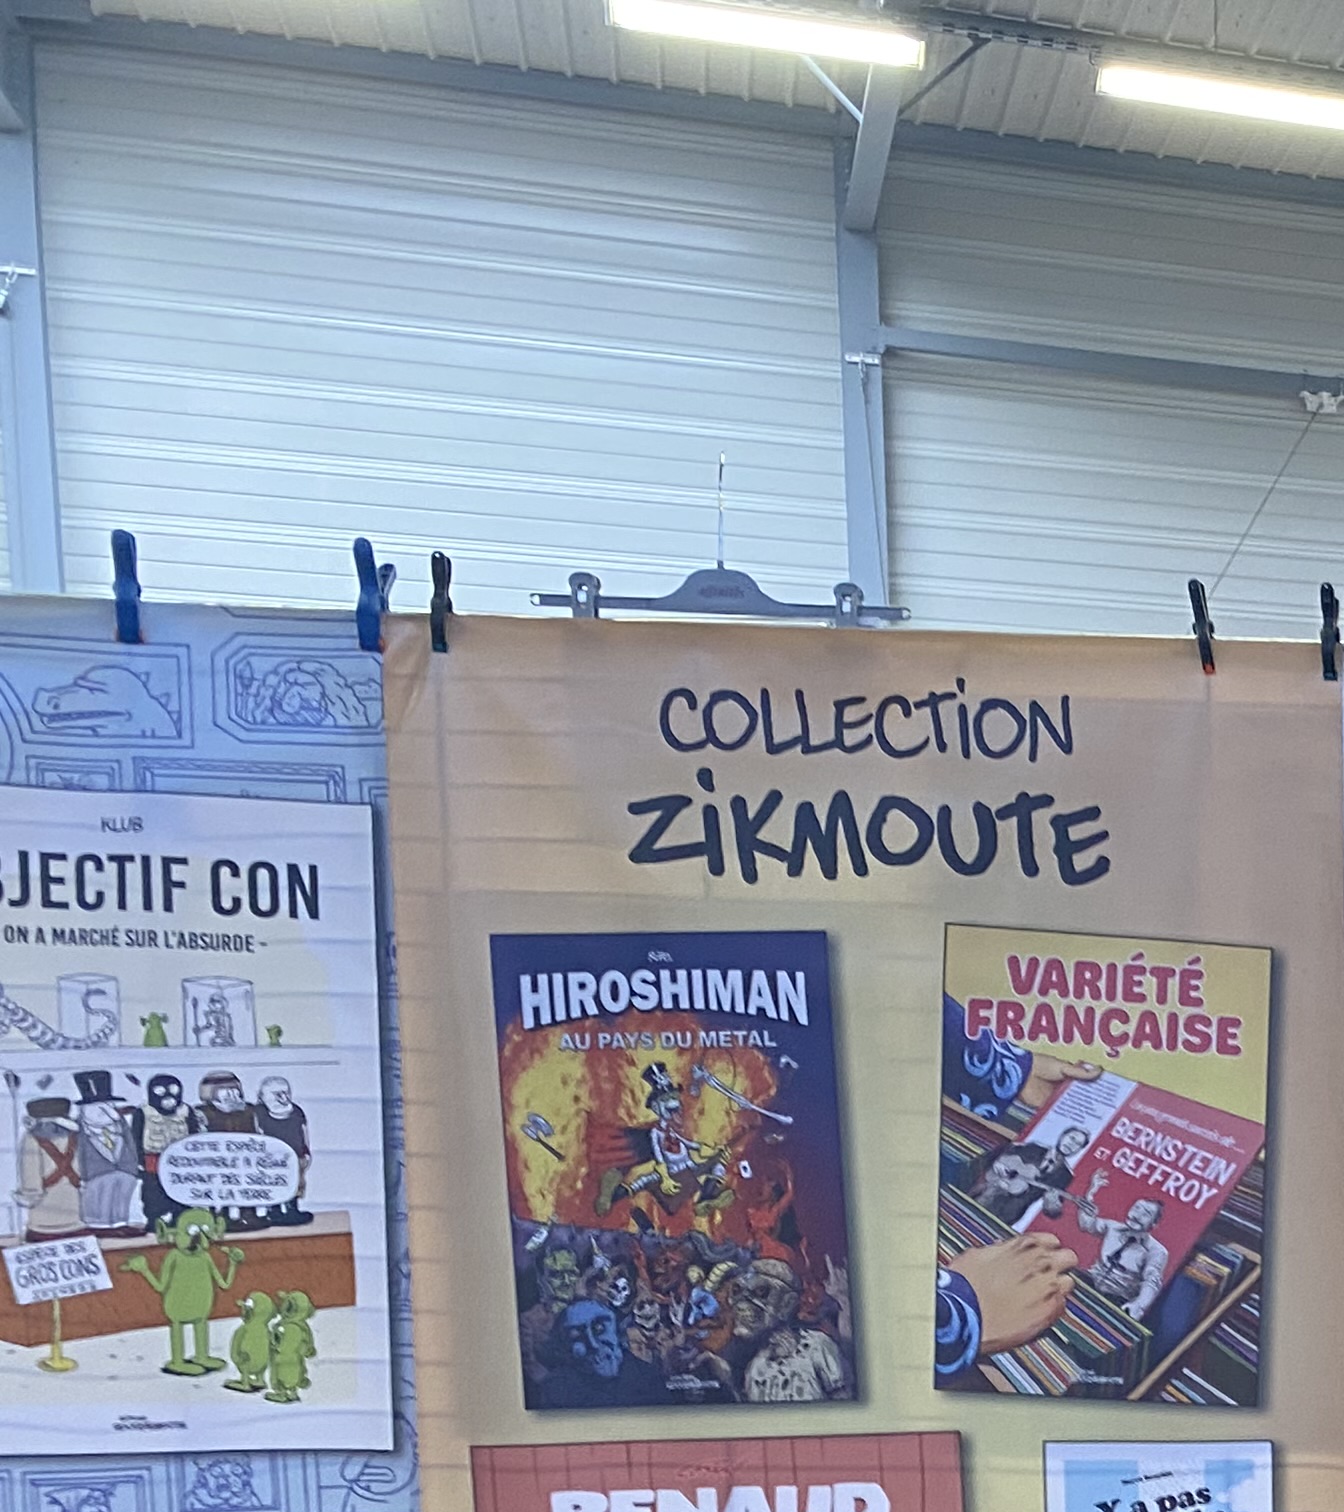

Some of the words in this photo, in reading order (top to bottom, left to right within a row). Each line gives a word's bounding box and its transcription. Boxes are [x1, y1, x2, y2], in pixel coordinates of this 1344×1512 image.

[101, 816, 144, 833] KLUB
[210, 858, 321, 920] CON
[3, 924, 29, 945] ON
[34, 927, 51, 946] A
[51, 924, 120, 948] MARCHÉ
[124, 929, 160, 950] SUR
[163, 929, 257, 954] L'ABSURDE
[519, 968, 809, 1030] HIROSHIMAN
[1005, 951, 1205, 1008] VARIÉTÉ
[559, 1032, 591, 1052] AU
[598, 1031, 655, 1050] PAYS
[664, 1030, 693, 1049] DU
[699, 1029, 778, 1049] METAL
[964, 997, 1243, 1058] FRANÇAISE
[1110, 1115, 1238, 1186] BERNSTEIN
[1112, 1147, 1219, 1211] GEFFROY
